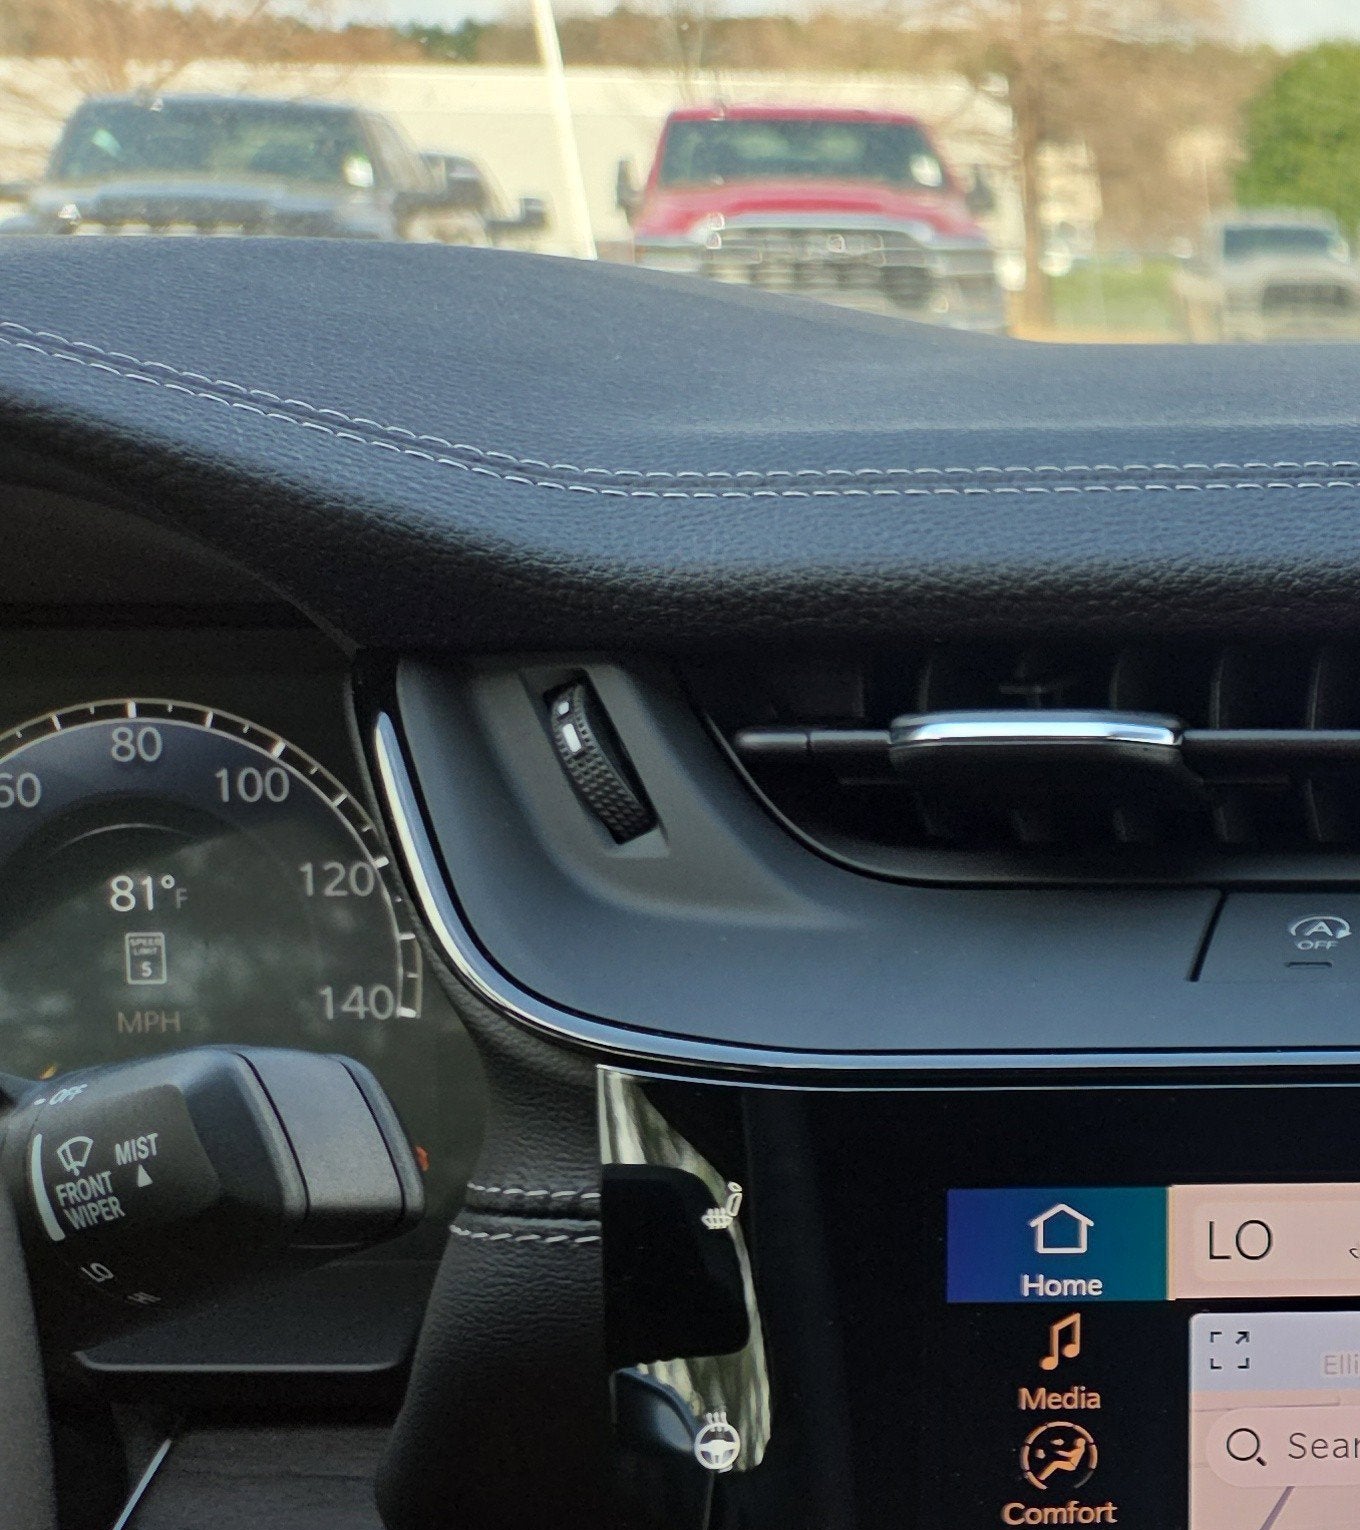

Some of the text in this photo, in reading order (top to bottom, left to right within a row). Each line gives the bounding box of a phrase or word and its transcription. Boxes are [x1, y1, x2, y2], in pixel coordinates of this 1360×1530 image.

[111, 727, 162, 762] 80
[215, 767, 290, 803] 100
[300, 861, 375, 898] 120
[1297, 939, 1339, 950] OFF
[320, 985, 394, 1020] 140
[117, 1010, 181, 1034] MPH
[49, 1083, 88, 1106] OFF
[114, 1132, 159, 1166] MIST
[55, 1170, 113, 1207] FRONT
[62, 1196, 126, 1230] WIPER
[1208, 1220, 1274, 1262] LO
[1022, 1275, 1103, 1298] Home
[1018, 1387, 1102, 1410] Media
[1002, 1502, 1118, 1526] Comfort
